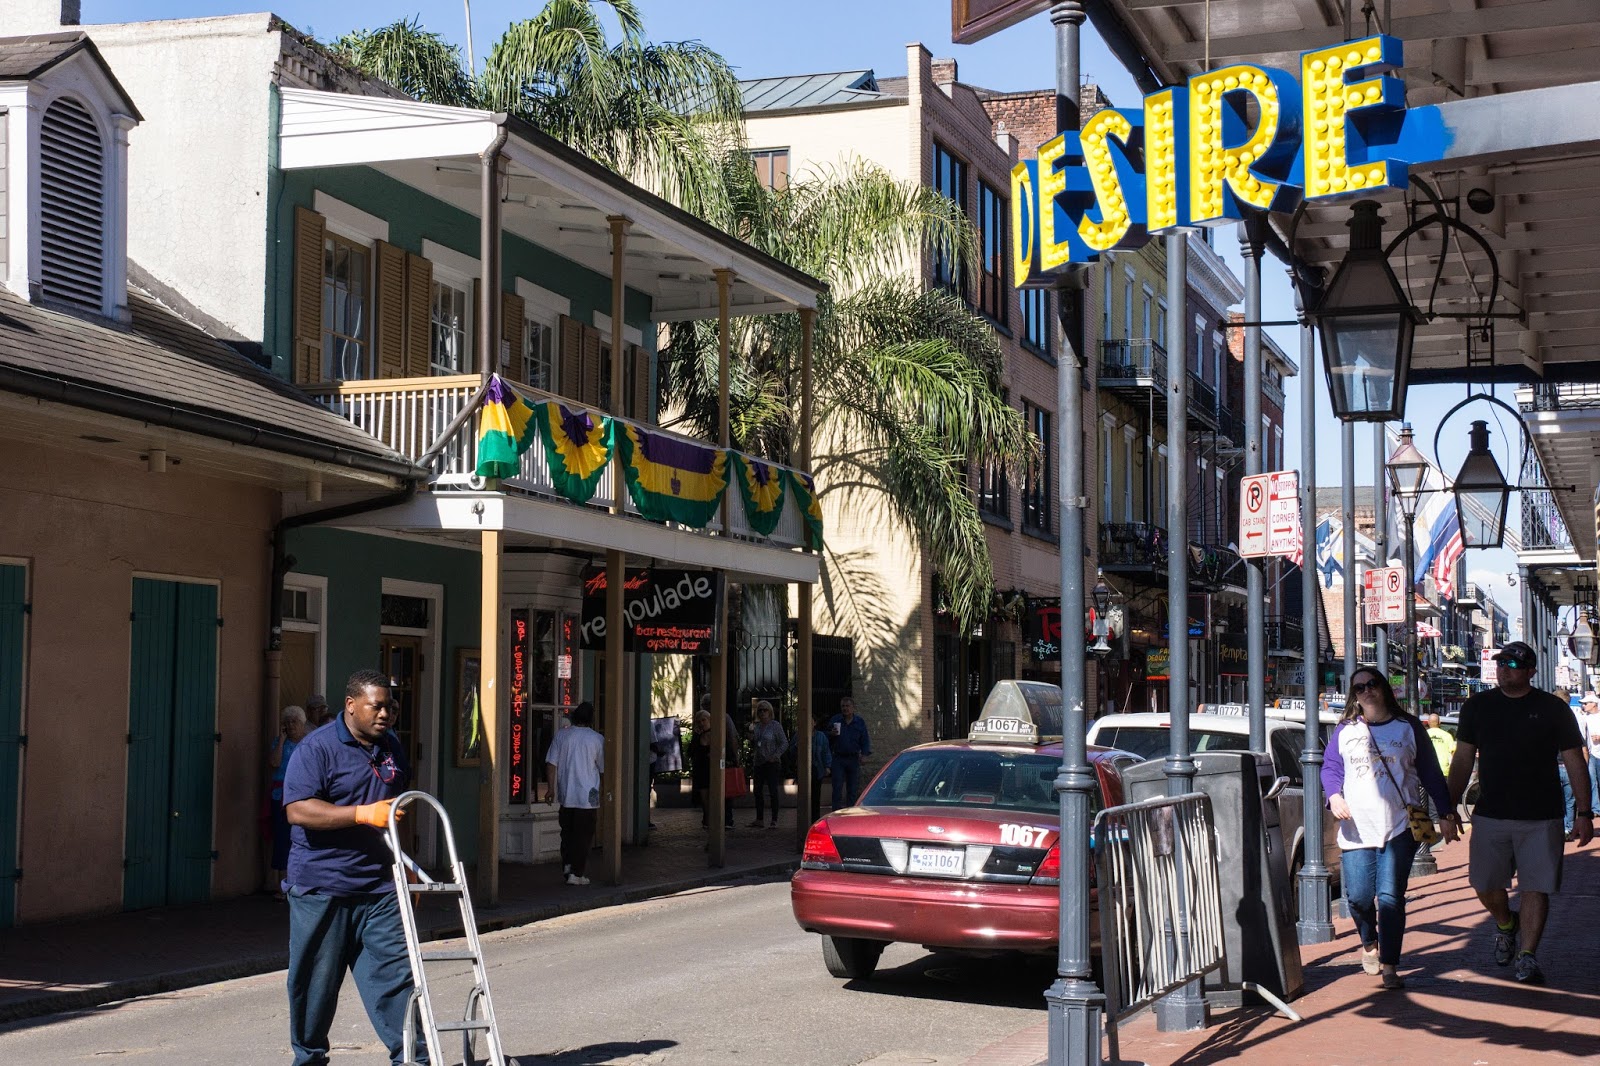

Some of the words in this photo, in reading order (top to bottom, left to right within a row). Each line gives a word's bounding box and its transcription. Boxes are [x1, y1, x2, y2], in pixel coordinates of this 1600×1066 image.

[1011, 35, 1405, 289] DESIRE
[1280, 501, 1287, 510] TO
[1243, 519, 1251, 527] CAB
[1253, 517, 1266, 525] STAND
[1272, 513, 1295, 523] CORNER
[1271, 538, 1295, 547] ANYTIME
[580, 573, 712, 644] reoulade
[517, 620, 525, 641] bar
[647, 638, 679, 650] oyster
[681, 639, 700, 650] bar
[1220, 644, 1248, 662] Tempta
[514, 645, 523, 716] restaurant
[1220, 705, 1240, 716] 0772
[988, 719, 1017, 731] 1067
[513, 724, 521, 766] oyster
[513, 774, 521, 797] bar
[999, 823, 1049, 848] 1067
[935, 854, 960, 868] 1067
